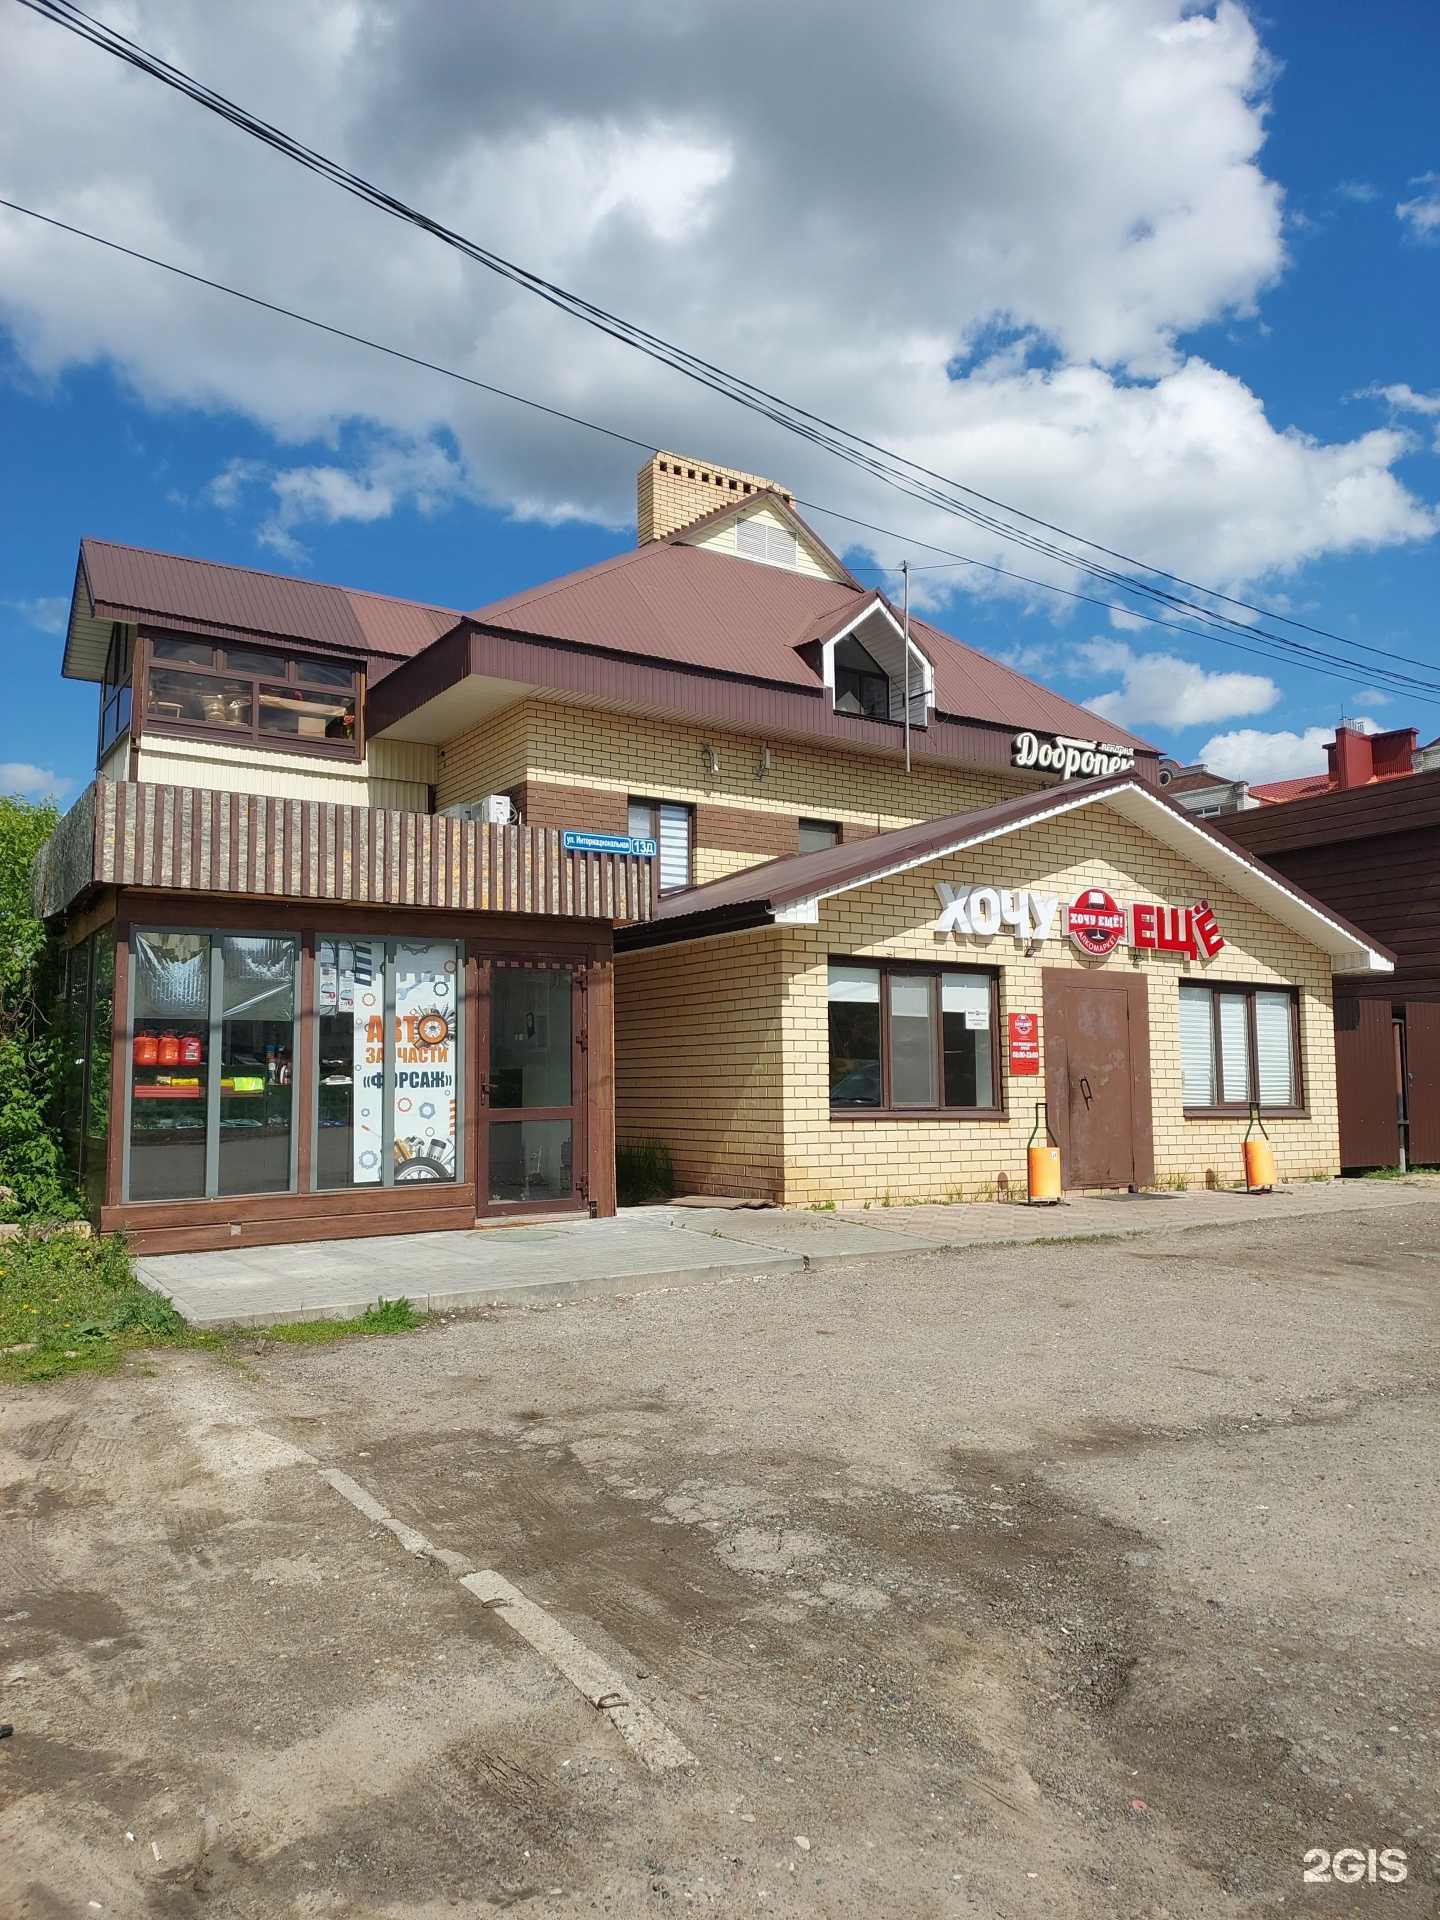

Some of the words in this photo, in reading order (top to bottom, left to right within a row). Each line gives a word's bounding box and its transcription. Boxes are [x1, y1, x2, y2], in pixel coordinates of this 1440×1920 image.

[634, 840, 654, 853] 13Д
[934, 882, 1059, 940] ХОЧУ
[1131, 900, 1225, 960] ЕЩЁ
[1070, 913, 1096, 926] ХОЧУ
[1098, 914, 1123, 928] ЕЩЁ!
[366, 1047, 448, 1063] ЗАЧАСТИ
[364, 1071, 452, 1088] «ФРСАЖ»
